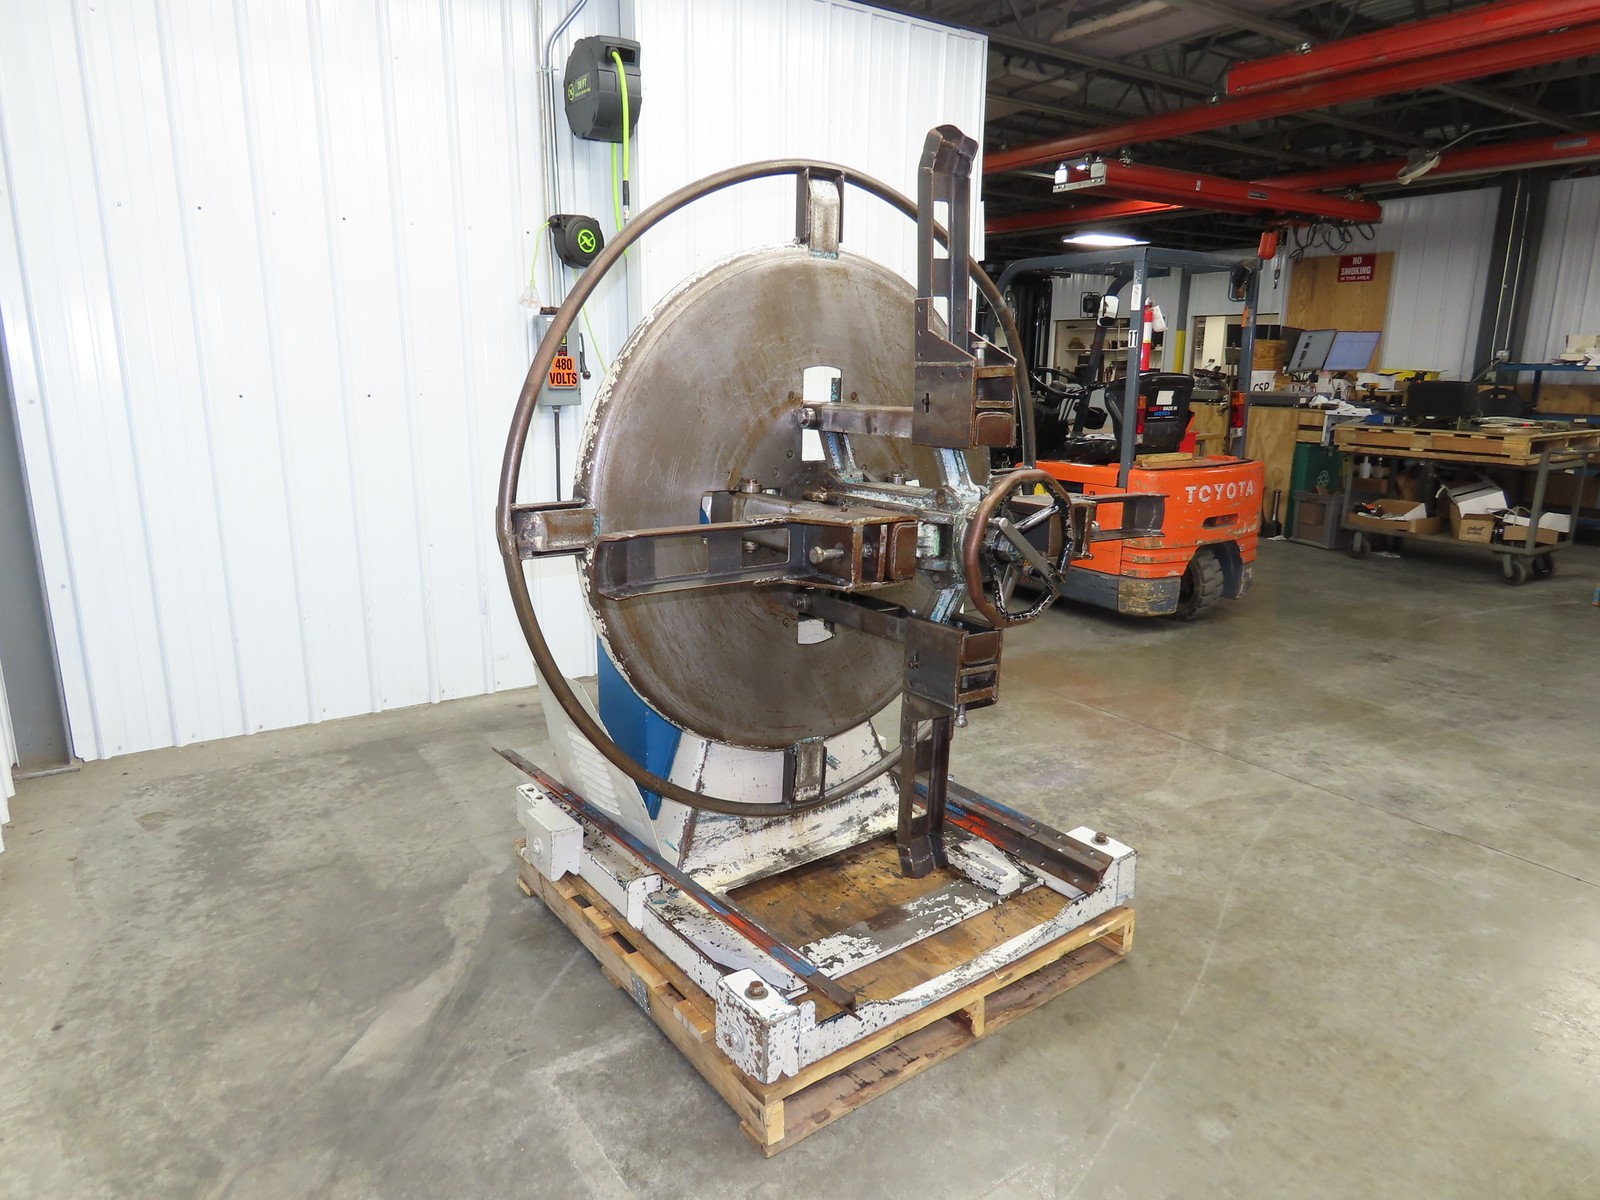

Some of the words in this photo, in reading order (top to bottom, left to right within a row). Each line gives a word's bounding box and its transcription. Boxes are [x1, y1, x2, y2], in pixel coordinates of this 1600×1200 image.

[1352, 256, 1362, 265] NO
[1341, 266, 1372, 276] SMOKING
[1129, 330, 1138, 347] 11
[555, 358, 573, 371] 480
[549, 372, 578, 385] VOLTS
[1185, 480, 1254, 504] TOYOTA
